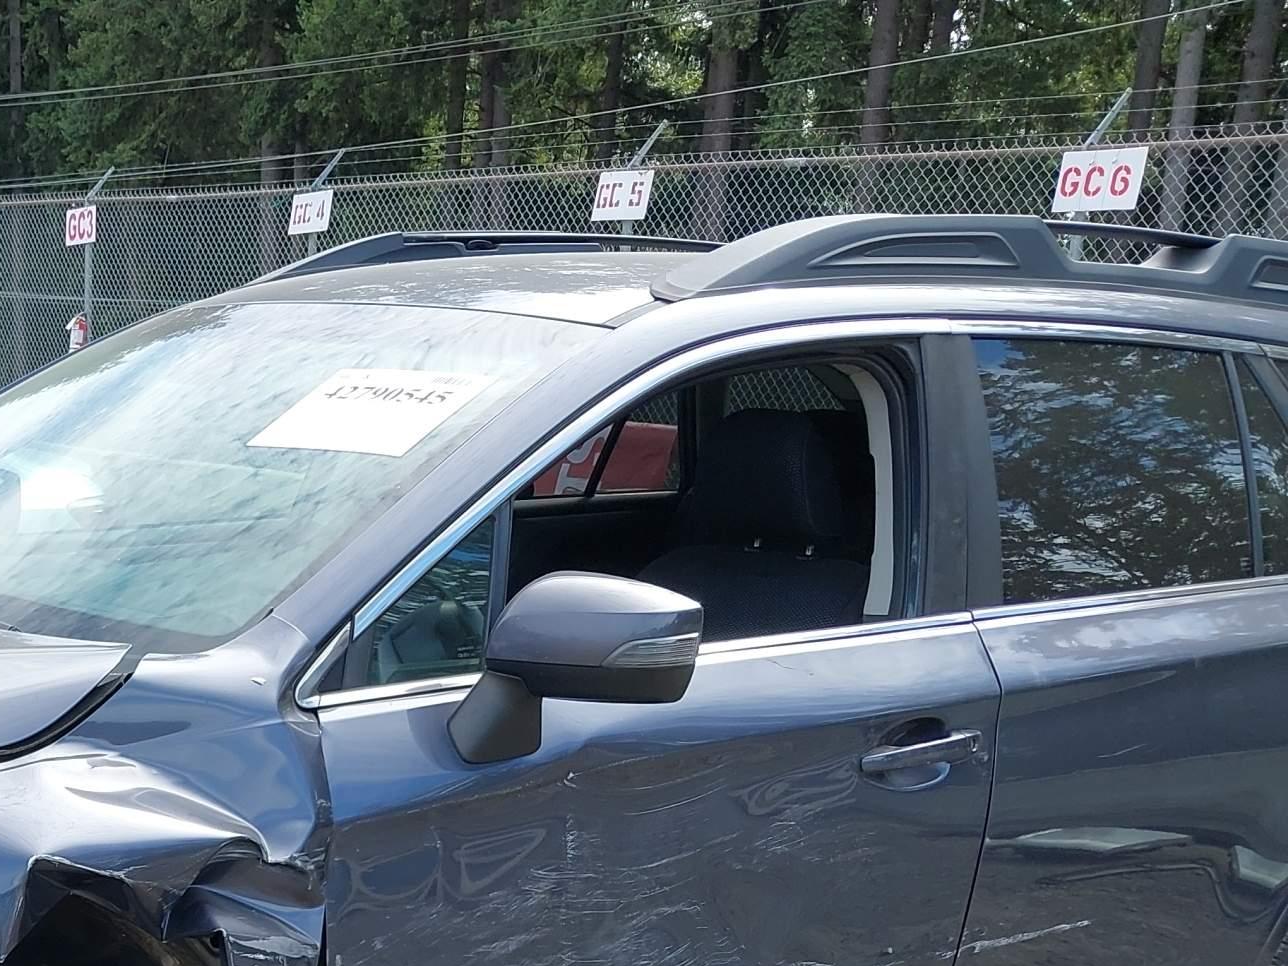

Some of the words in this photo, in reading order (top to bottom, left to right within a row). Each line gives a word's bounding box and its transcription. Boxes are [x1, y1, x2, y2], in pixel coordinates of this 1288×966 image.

[596, 182, 623, 208] GC
[628, 181, 644, 207] 5
[1060, 164, 1132, 197] GC6
[68, 210, 94, 241] GC3
[292, 202, 312, 225] GC
[316, 200, 326, 221] 4
